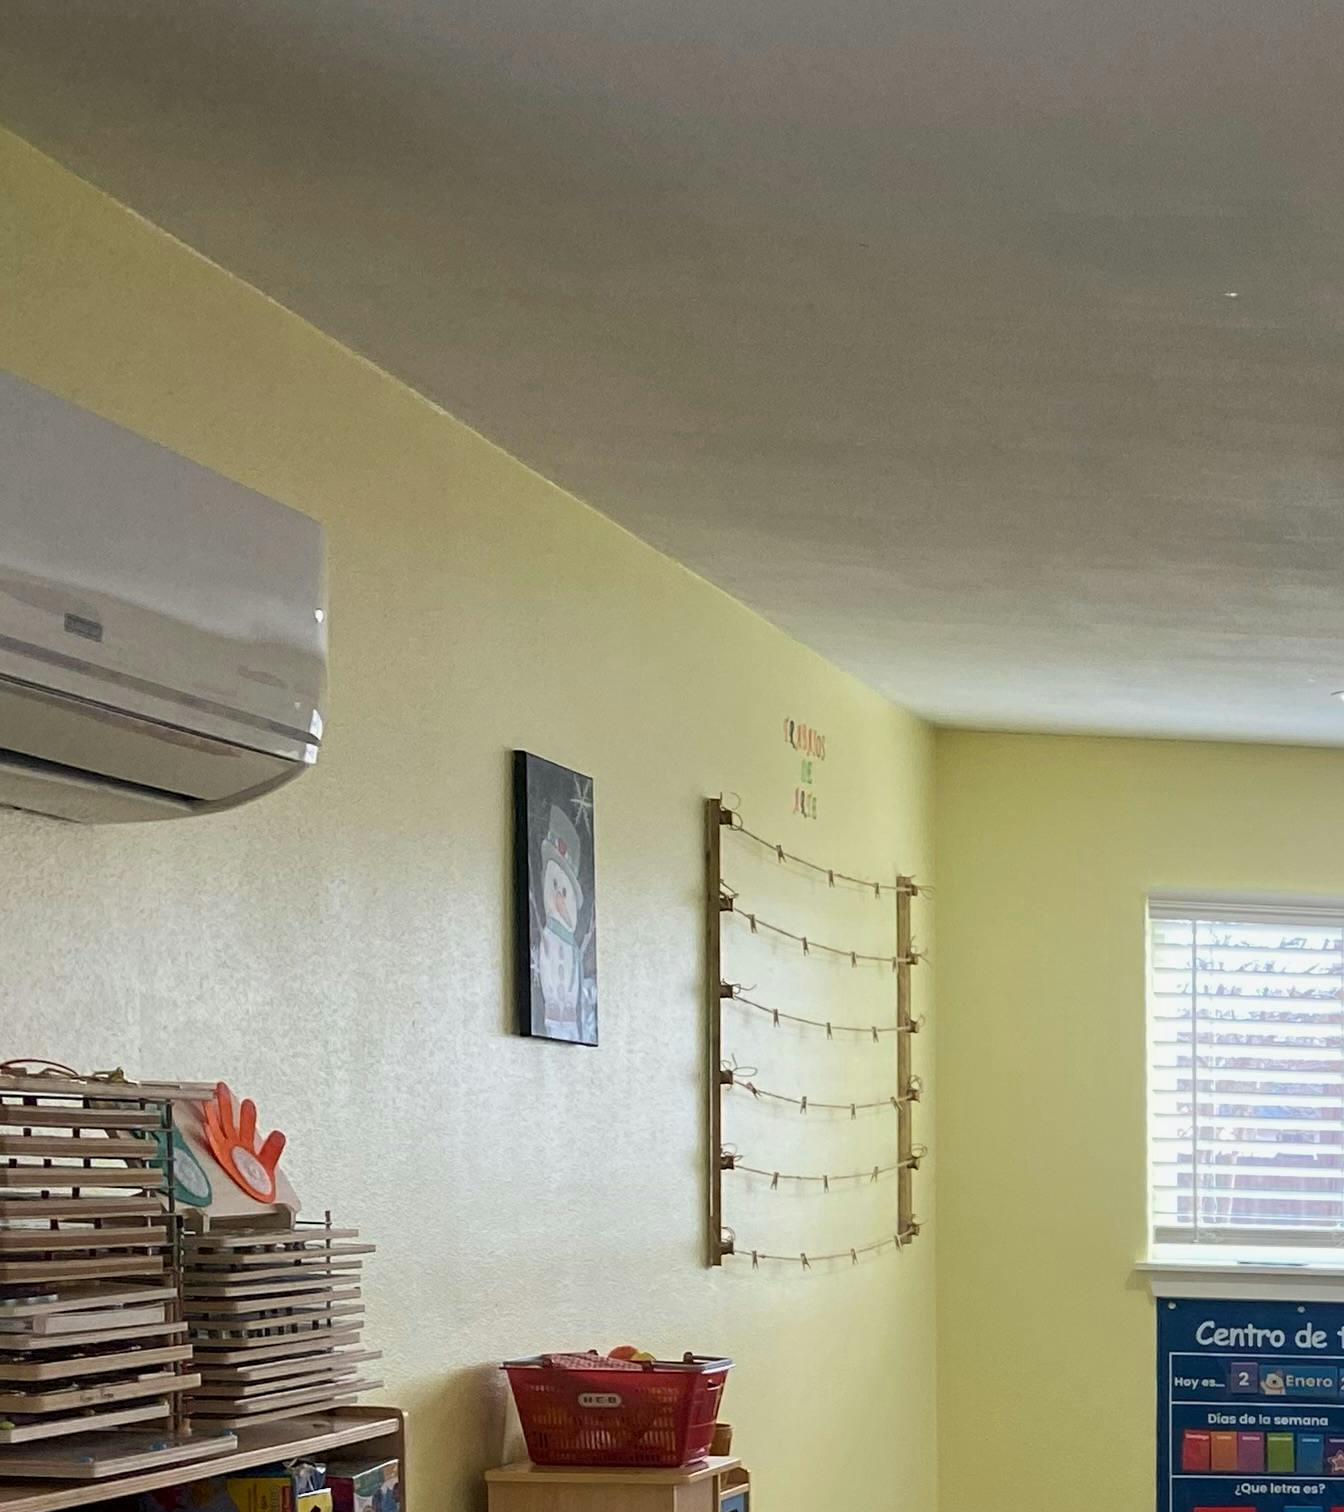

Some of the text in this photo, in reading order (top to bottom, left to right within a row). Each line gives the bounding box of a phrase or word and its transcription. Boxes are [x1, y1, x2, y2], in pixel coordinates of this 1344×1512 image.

[1196, 1321, 1284, 1349] Centro
[1295, 1325, 1327, 1348] de
[1174, 1377, 1199, 1390] Hoy
[1239, 1373, 1249, 1386] 2
[1286, 1375, 1332, 1388] Enero
[1208, 1413, 1328, 1427] Días de la semana
[1235, 1483, 1326, 1496] ¿Que letra es?
